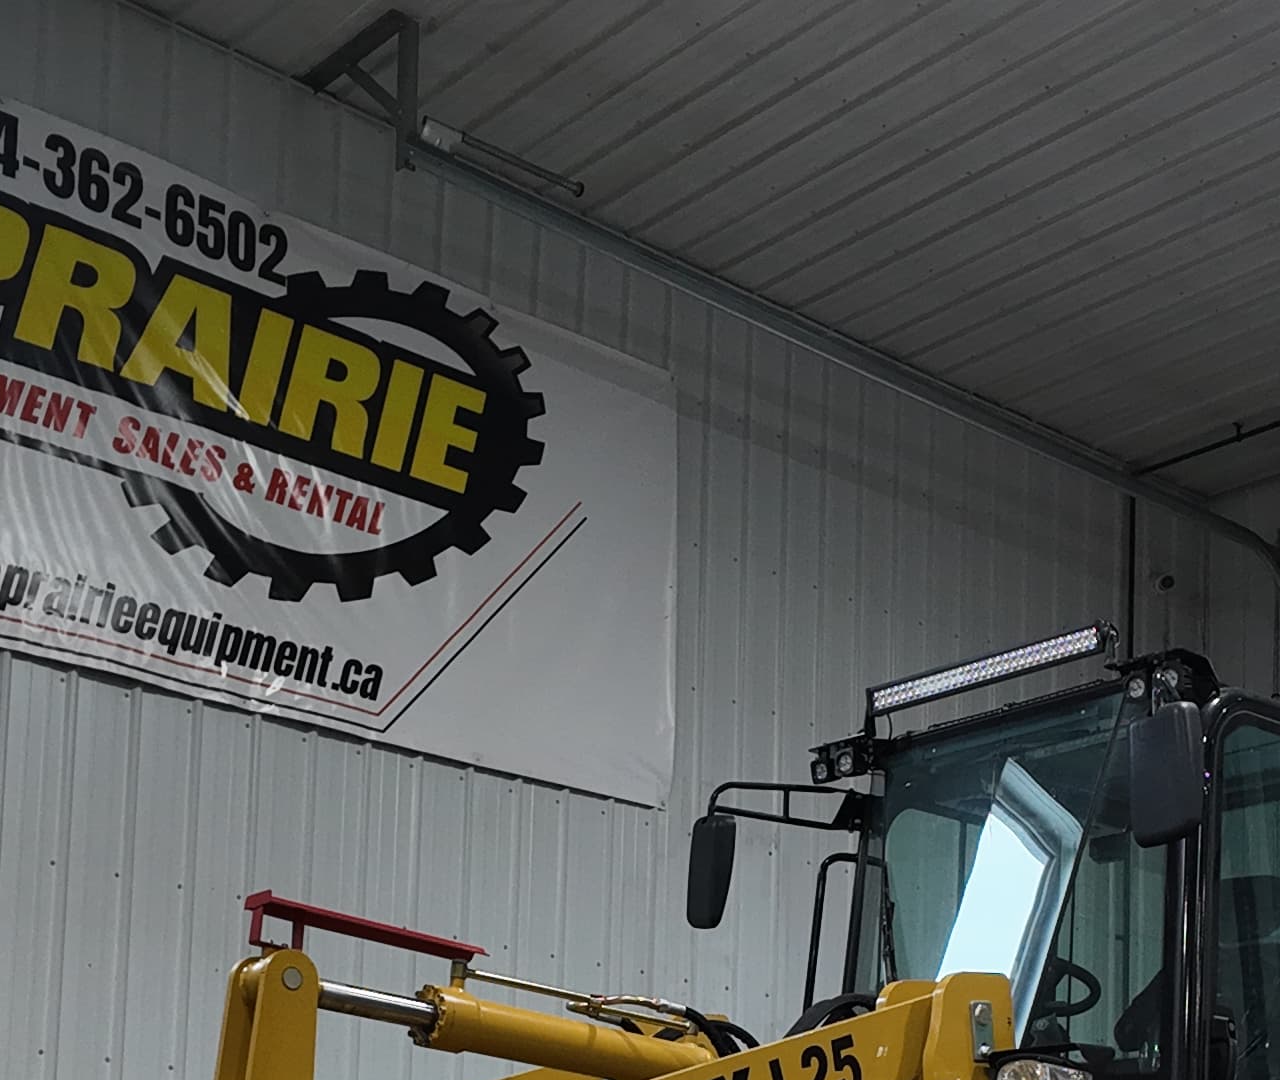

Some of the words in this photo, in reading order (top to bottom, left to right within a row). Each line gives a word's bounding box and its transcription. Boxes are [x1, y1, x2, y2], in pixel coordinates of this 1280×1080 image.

[112, 415, 226, 482] SALES
[232, 462, 256, 494] &
[264, 467, 386, 535] RENTAL
